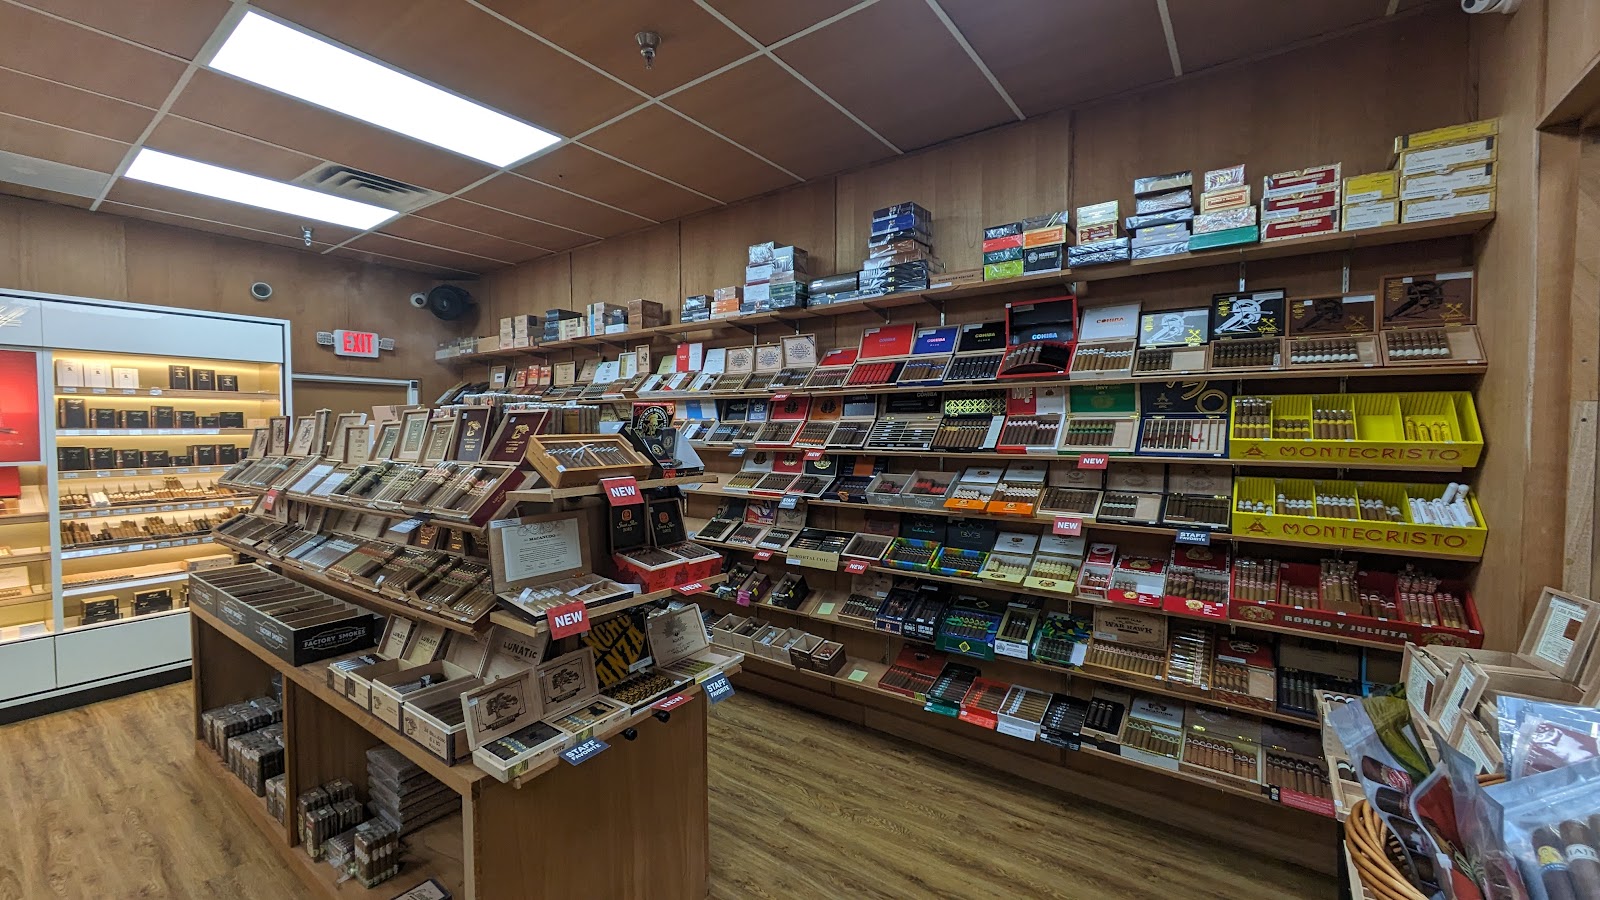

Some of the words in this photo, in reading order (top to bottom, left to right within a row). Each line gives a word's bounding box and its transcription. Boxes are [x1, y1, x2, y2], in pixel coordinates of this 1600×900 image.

[343, 331, 373, 354] EXIT
[1032, 332, 1058, 340] COHIBA
[1083, 457, 1105, 465] NEW
[1279, 446, 1461, 461] MONTECRISTO
[610, 486, 636, 498] NEW
[1057, 521, 1078, 530] NEW
[1282, 522, 1467, 549] MONTECRISTO
[849, 563, 865, 571] NEW
[679, 582, 703, 592] NEW
[554, 610, 583, 628] NEW
[1105, 621, 1125, 629] WAR
[1126, 625, 1153, 634] HAWK
[1284, 615, 1331, 628] ROMEO
[1336, 622, 1345, 630] Y
[1350, 625, 1408, 640] JULIETA
[304, 635, 336, 647] FACTORY
[338, 630, 366, 640] SMOKES
[503, 640, 538, 659] LUNATIC
[706, 678, 727, 693] STAFF
[710, 684, 731, 698] FAVORITE
[660, 695, 684, 708] NEW
[565, 740, 595, 758] STAFF
[571, 743, 602, 761] FAVORITE
